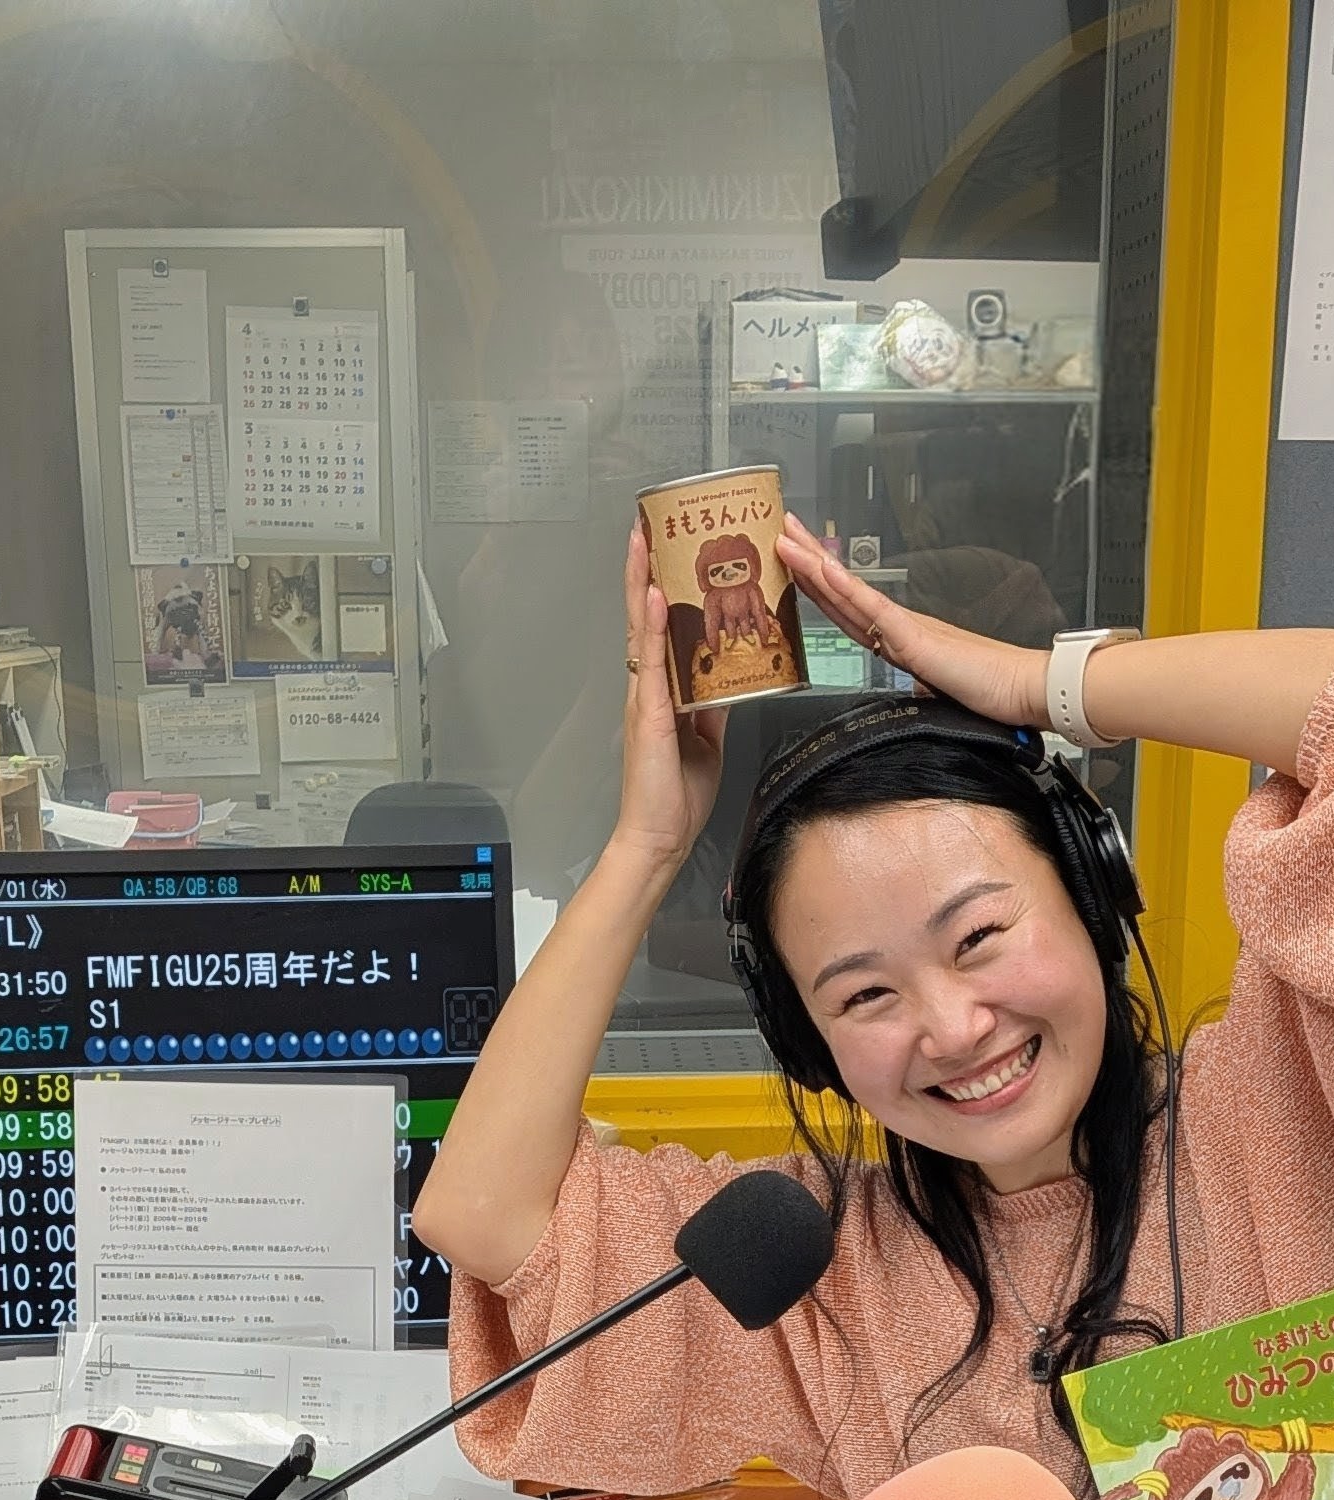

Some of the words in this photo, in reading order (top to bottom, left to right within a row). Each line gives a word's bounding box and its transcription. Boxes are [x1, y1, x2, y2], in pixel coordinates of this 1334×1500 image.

[242, 323, 252, 335] 4
[318, 343, 324, 352] 2
[337, 343, 342, 352] 3
[263, 356, 269, 365] 6
[282, 356, 287, 365] 7
[318, 358, 324, 366] 9
[334, 358, 346, 367] 10
[352, 359, 363, 367] 11
[243, 371, 254, 379] 12
[261, 371, 272, 380] 13
[279, 371, 291, 380] 14
[298, 372, 309, 380] 15
[316, 372, 327, 381] 16
[334, 373, 345, 381] 17
[243, 385, 255, 394] 19
[261, 385, 273, 394] 20
[279, 386, 291, 394] 21
[298, 386, 309, 395] 22
[316, 387, 327, 396] 23
[334, 387, 345, 396] 24
[352, 388, 363, 397] 25
[243, 400, 255, 408] 26
[261, 400, 273, 408] 27
[279, 401, 291, 409] 28
[298, 401, 309, 410] 29
[316, 401, 328, 410] 30
[244, 422, 253, 434] 3
[265, 440, 271, 448] 2
[283, 440, 288, 449] 3
[701, 491, 730, 503] Wonder
[664, 500, 773, 540] まもるんパン
[289, 712, 381, 726] 0120-68-4424
[843, 706, 920, 732] STUDIO
[124, 876, 238, 897] QA:58/QB:68
[289, 874, 321, 894] A/M
[360, 874, 412, 892] SYS-A
[460, 873, 492, 890] 現用
[86, 950, 419, 989] FMFIGU25周年だよ！
[89, 999, 122, 1029] S1
